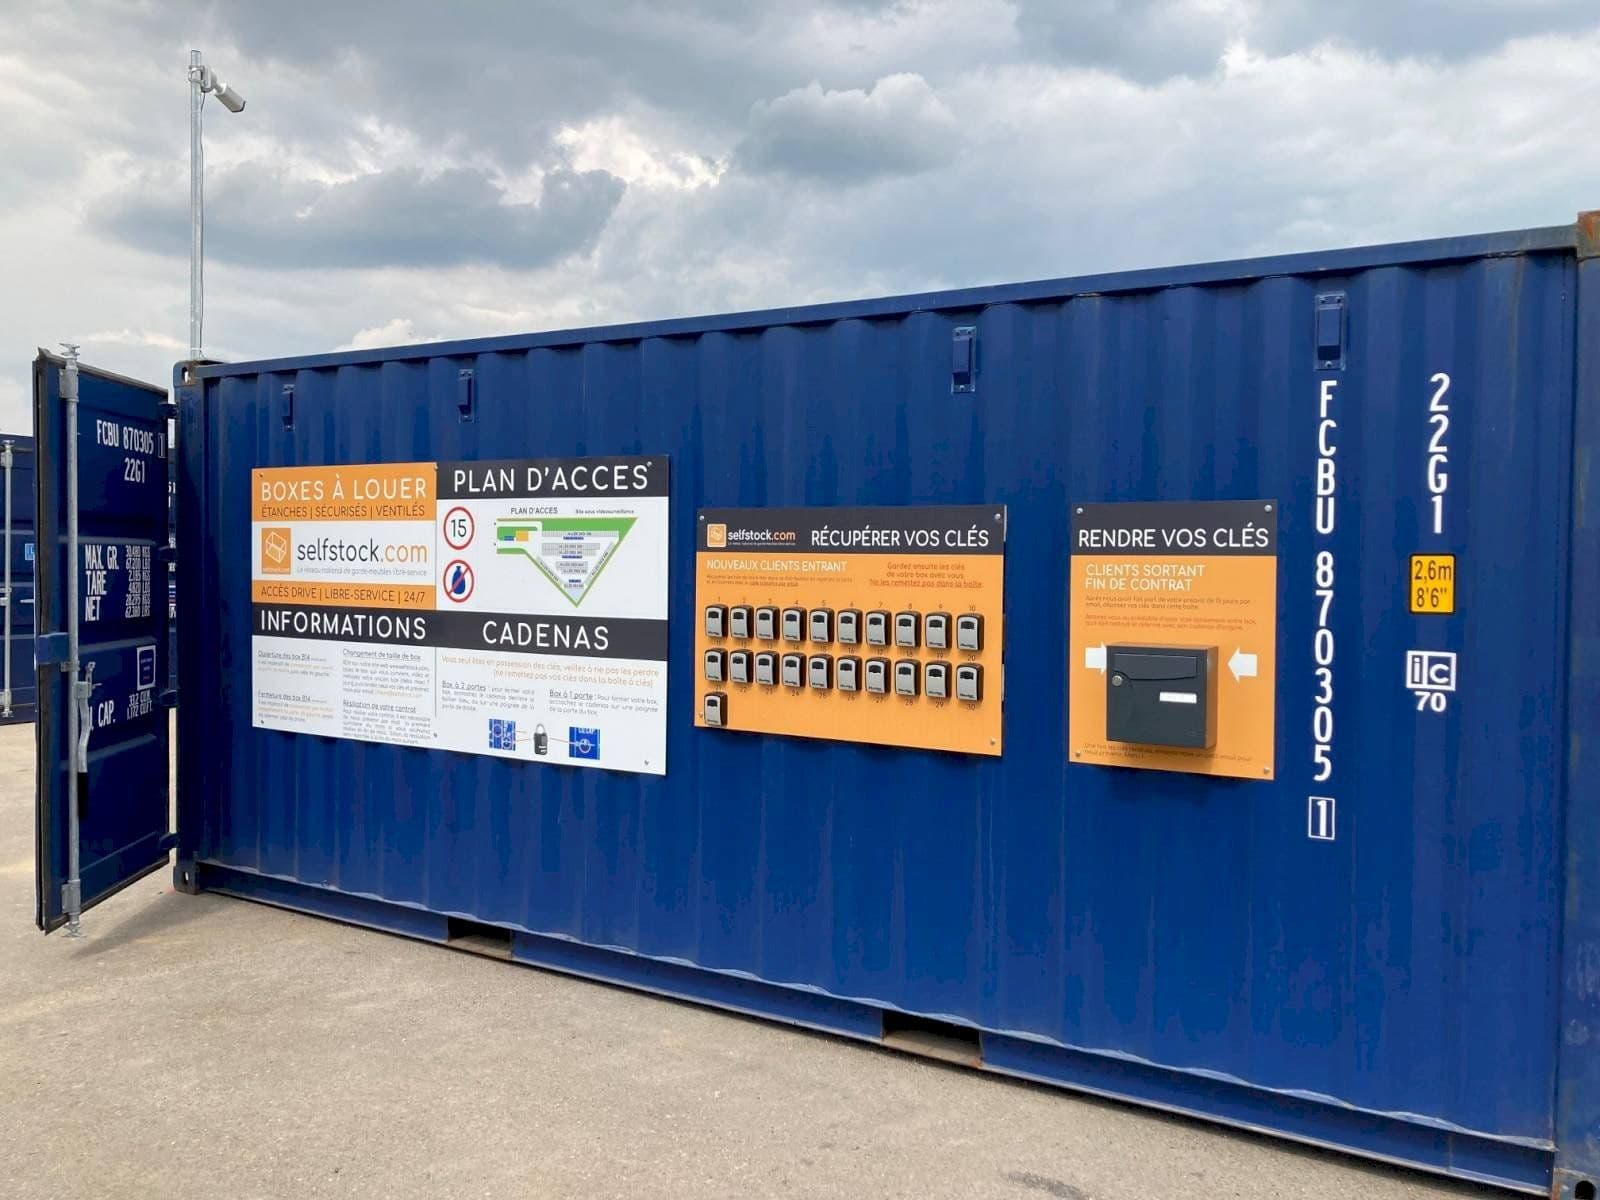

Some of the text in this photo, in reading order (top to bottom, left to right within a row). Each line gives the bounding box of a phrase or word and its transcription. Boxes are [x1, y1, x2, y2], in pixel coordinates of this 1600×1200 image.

[96, 419, 119, 447] FCBU
[123, 426, 154, 455] 870305
[1315, 380, 1338, 534] FCBU
[1427, 372, 1451, 534] 22G1
[124, 457, 145, 484] 22G1
[454, 465, 648, 492] PLAN D'ACCES
[261, 474, 426, 501] BOXES À LOUER
[261, 502, 425, 518] ÉTANCHES SÉCURISÉS VENTILÉS
[450, 518, 467, 538] 15
[728, 525, 989, 547] selfstock.com RÉCUPÉRER VOS CLÉS
[1079, 522, 1269, 548] RENDRE VOS CLÉS
[85, 544, 104, 570] MAX.
[107, 546, 119, 570] GR.
[297, 538, 427, 563] selfstock.com
[706, 559, 848, 572] NOUVEAUX CLIENTS ENTRANT
[1086, 564, 1206, 577] CLIENTS SORTANT
[1414, 560, 1452, 583] 2,6m
[86, 570, 107, 596] TARE
[261, 584, 426, 603] ACCÈS DRIVE LIBRE-SERVICE 24/7
[1085, 577, 1192, 591] FIN DE CONTRAT
[85, 596, 101, 622] NET
[261, 610, 427, 640] INFORMATIONS
[482, 620, 609, 650] CADENAS
[1312, 551, 1336, 782] 870305
[550, 688, 561, 698] Box
[1414, 690, 1447, 712] 70
[98, 700, 116, 728] CAP.
